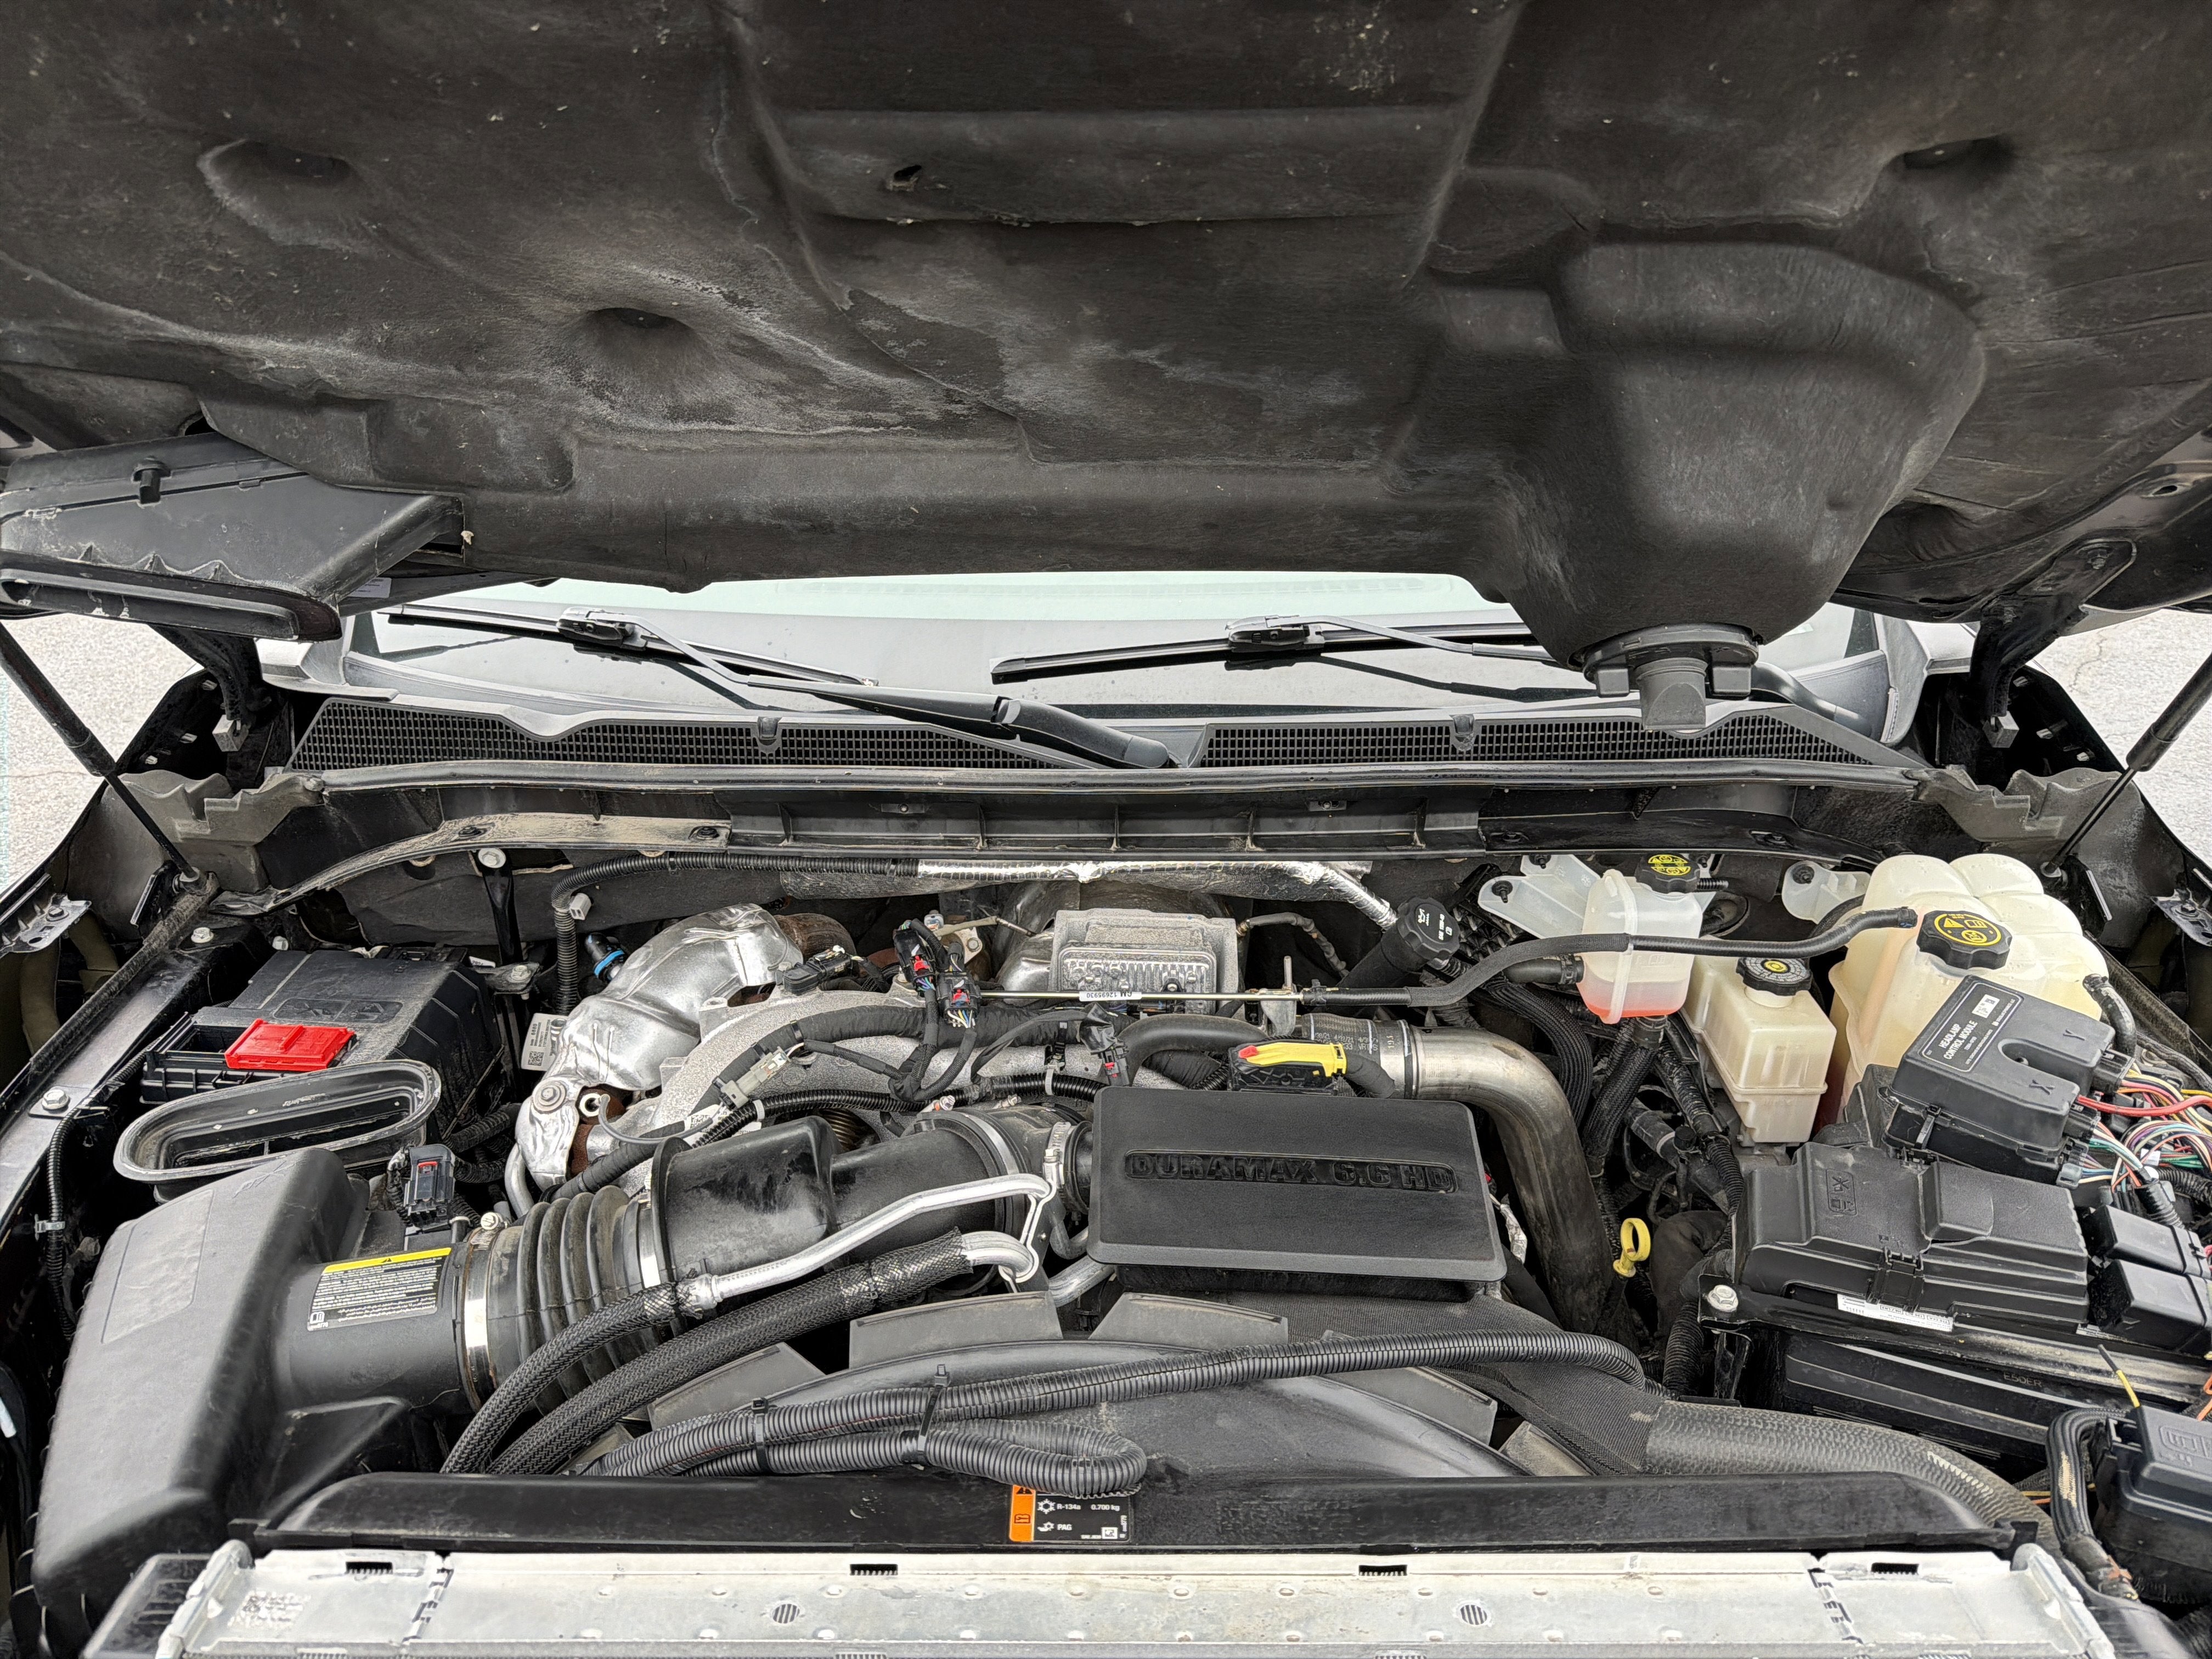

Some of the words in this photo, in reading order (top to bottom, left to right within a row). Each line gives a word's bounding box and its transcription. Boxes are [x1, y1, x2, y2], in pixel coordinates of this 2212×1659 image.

[1938, 1023, 1962, 1048] HEADLAMP
[1943, 1037, 1965, 1059] CONTROL
[1958, 1020, 1978, 1040] MODULE
[2062, 1028, 2085, 1041] Y
[2029, 1079, 2055, 1095] X
[1130, 1153, 1317, 1183] DURAMAX
[1331, 1161, 1391, 1187] 6.6
[1400, 1164, 1456, 1192] HD
